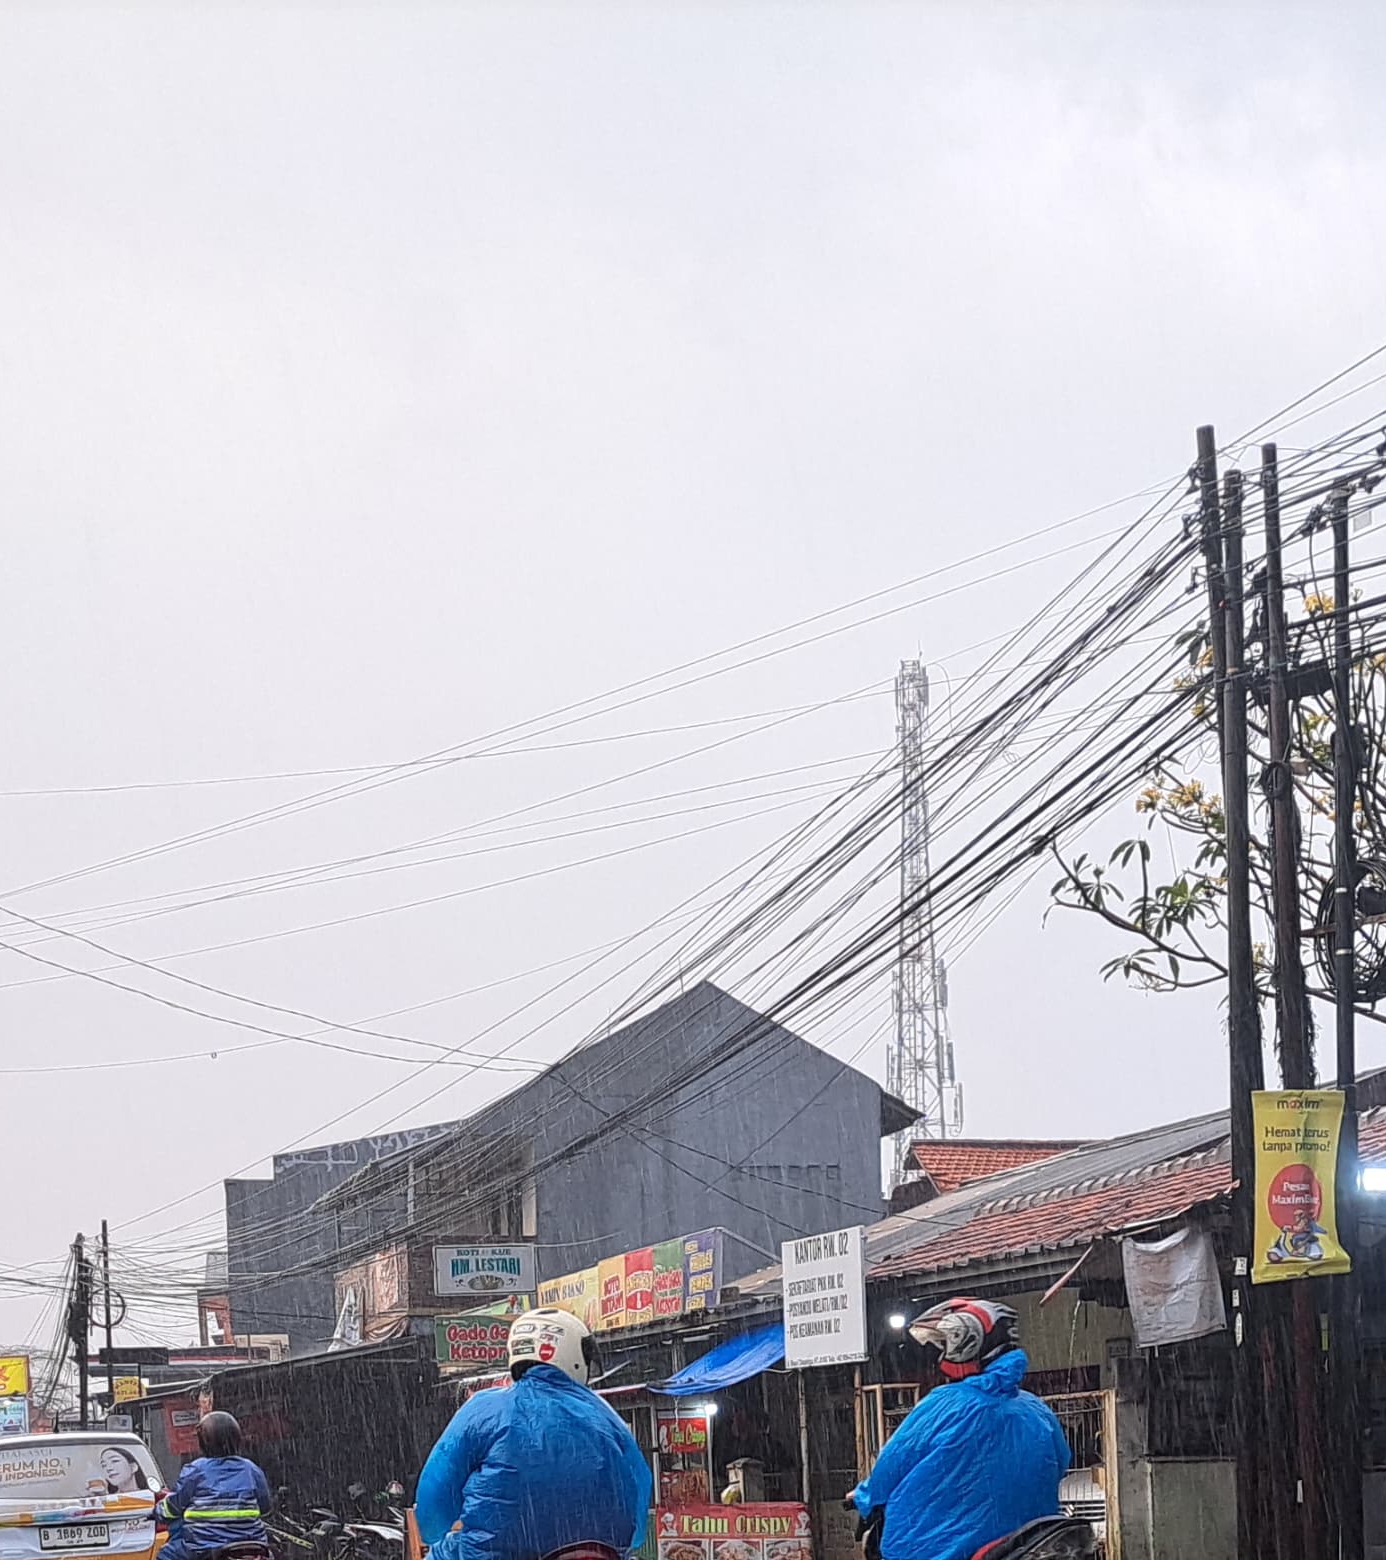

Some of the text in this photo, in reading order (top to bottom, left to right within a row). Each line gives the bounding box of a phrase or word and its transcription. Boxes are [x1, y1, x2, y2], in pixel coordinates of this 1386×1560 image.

[1277, 1097, 1320, 1110] maxim
[1265, 1126, 1329, 1138] Hemat terus
[1262, 1140, 1331, 1153] tanpa promo!
[795, 1239, 822, 1265] KANTOR
[838, 1231, 849, 1255] 02
[475, 1257, 521, 1276] LESTARI
[447, 1325, 487, 1342] Gado
[5, 1468, 66, 1482] INDONESIA
[735, 1514, 792, 1537] Crispy
[42, 1530, 50, 1541] B
